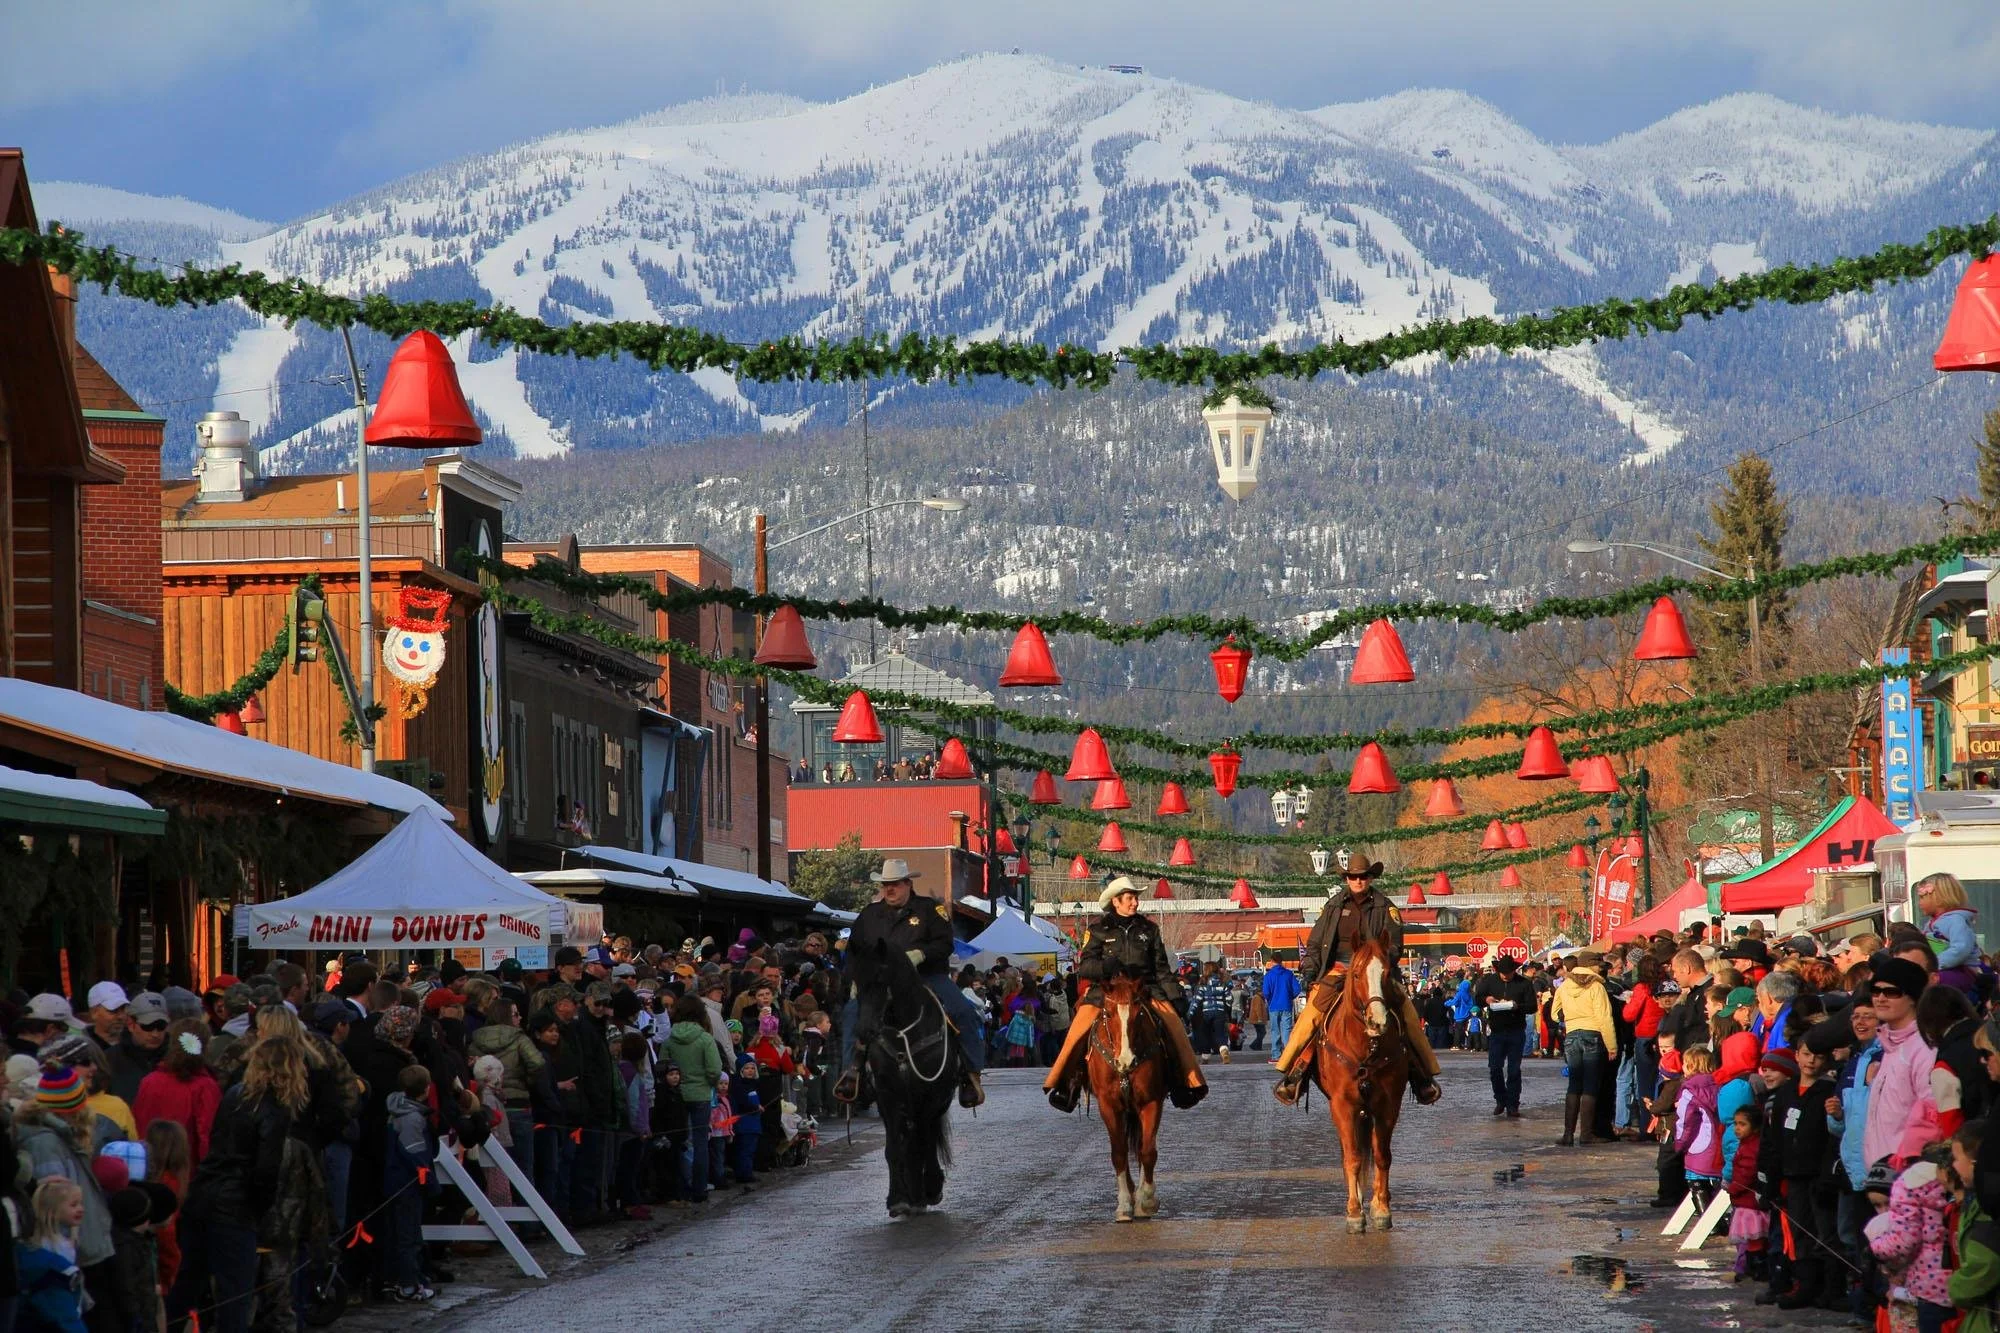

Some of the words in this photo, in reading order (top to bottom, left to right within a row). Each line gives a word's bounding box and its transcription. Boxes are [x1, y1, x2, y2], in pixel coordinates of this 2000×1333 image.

[257, 914, 299, 941] Fresh
[308, 915, 373, 943] MINI
[391, 913, 488, 942] DONUTS
[499, 913, 541, 940] DRINKS
[1468, 943, 1487, 953] STOP
[1499, 947, 1526, 959] STOP
[1446, 960, 1461, 969] STOP
